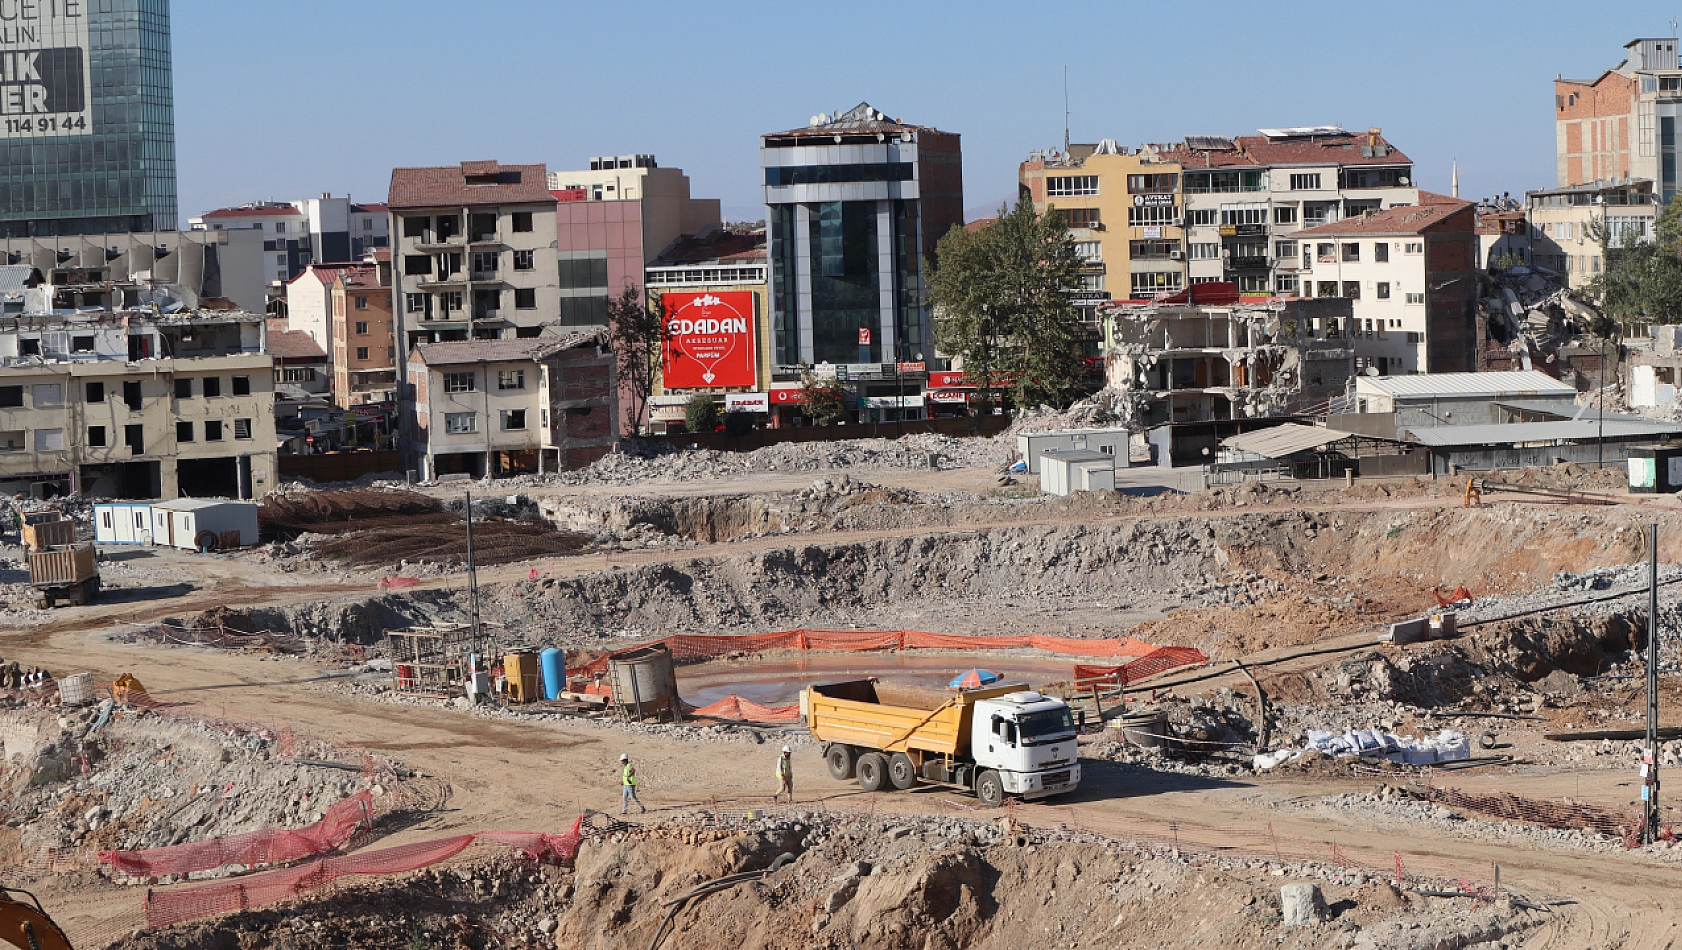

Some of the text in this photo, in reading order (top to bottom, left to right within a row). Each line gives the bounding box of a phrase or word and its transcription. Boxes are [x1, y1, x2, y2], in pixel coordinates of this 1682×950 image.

[0, 25, 40, 44] LIN.
[0, 51, 42, 82] IK
[5, 115, 86, 133] 114 91 44
[668, 317, 747, 335] EDADAN
